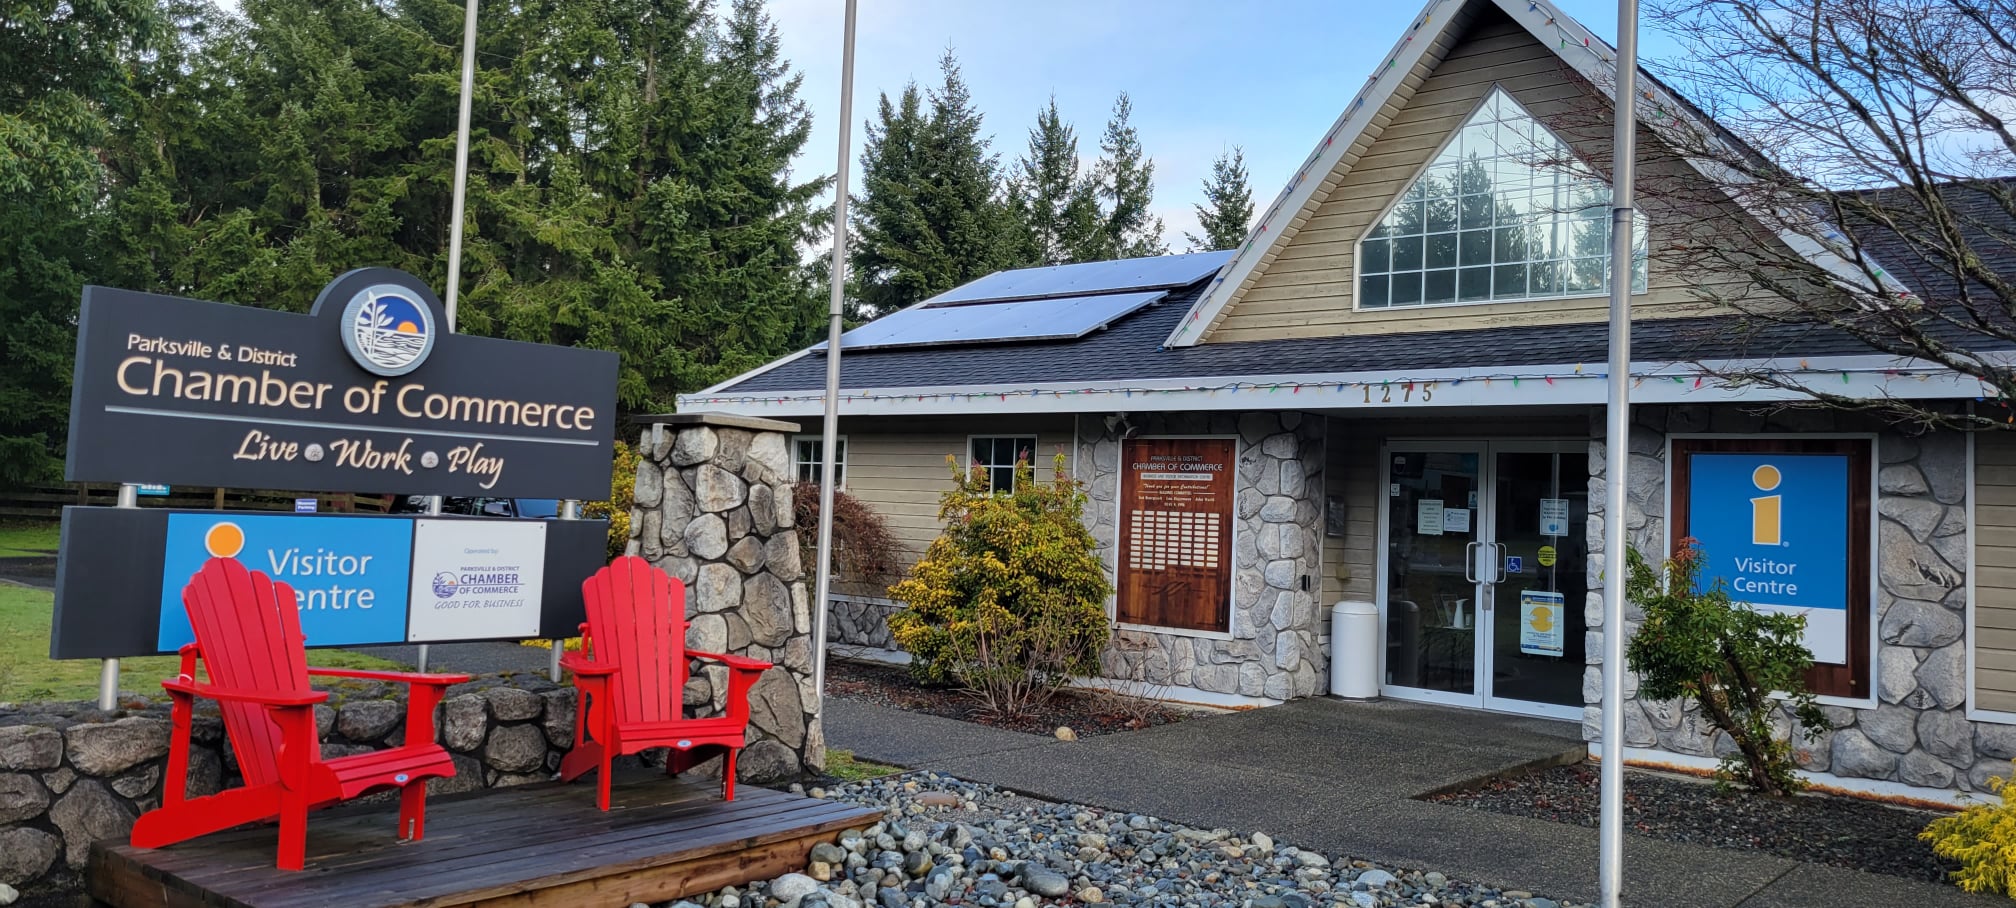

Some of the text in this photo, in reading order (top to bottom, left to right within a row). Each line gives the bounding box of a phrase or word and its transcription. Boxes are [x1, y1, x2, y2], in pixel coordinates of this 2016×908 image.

[127, 333, 298, 368] Parksville & District
[117, 356, 595, 431] Chamber of Commerce
[1363, 384, 1431, 403] 1275
[233, 429, 504, 490] Live Work Play
[1167, 463, 1178, 471] OF
[1179, 463, 1223, 471] COMMERCE
[267, 548, 373, 576] Visitor
[1734, 556, 1797, 575] Visitor
[460, 573, 519, 584] CHAMBER
[1733, 577, 1798, 596] Centre
[295, 584, 375, 610] entre
[459, 586, 519, 594] OF COMMERCE
[434, 599, 525, 610] GOOD FOR BUSINESS
